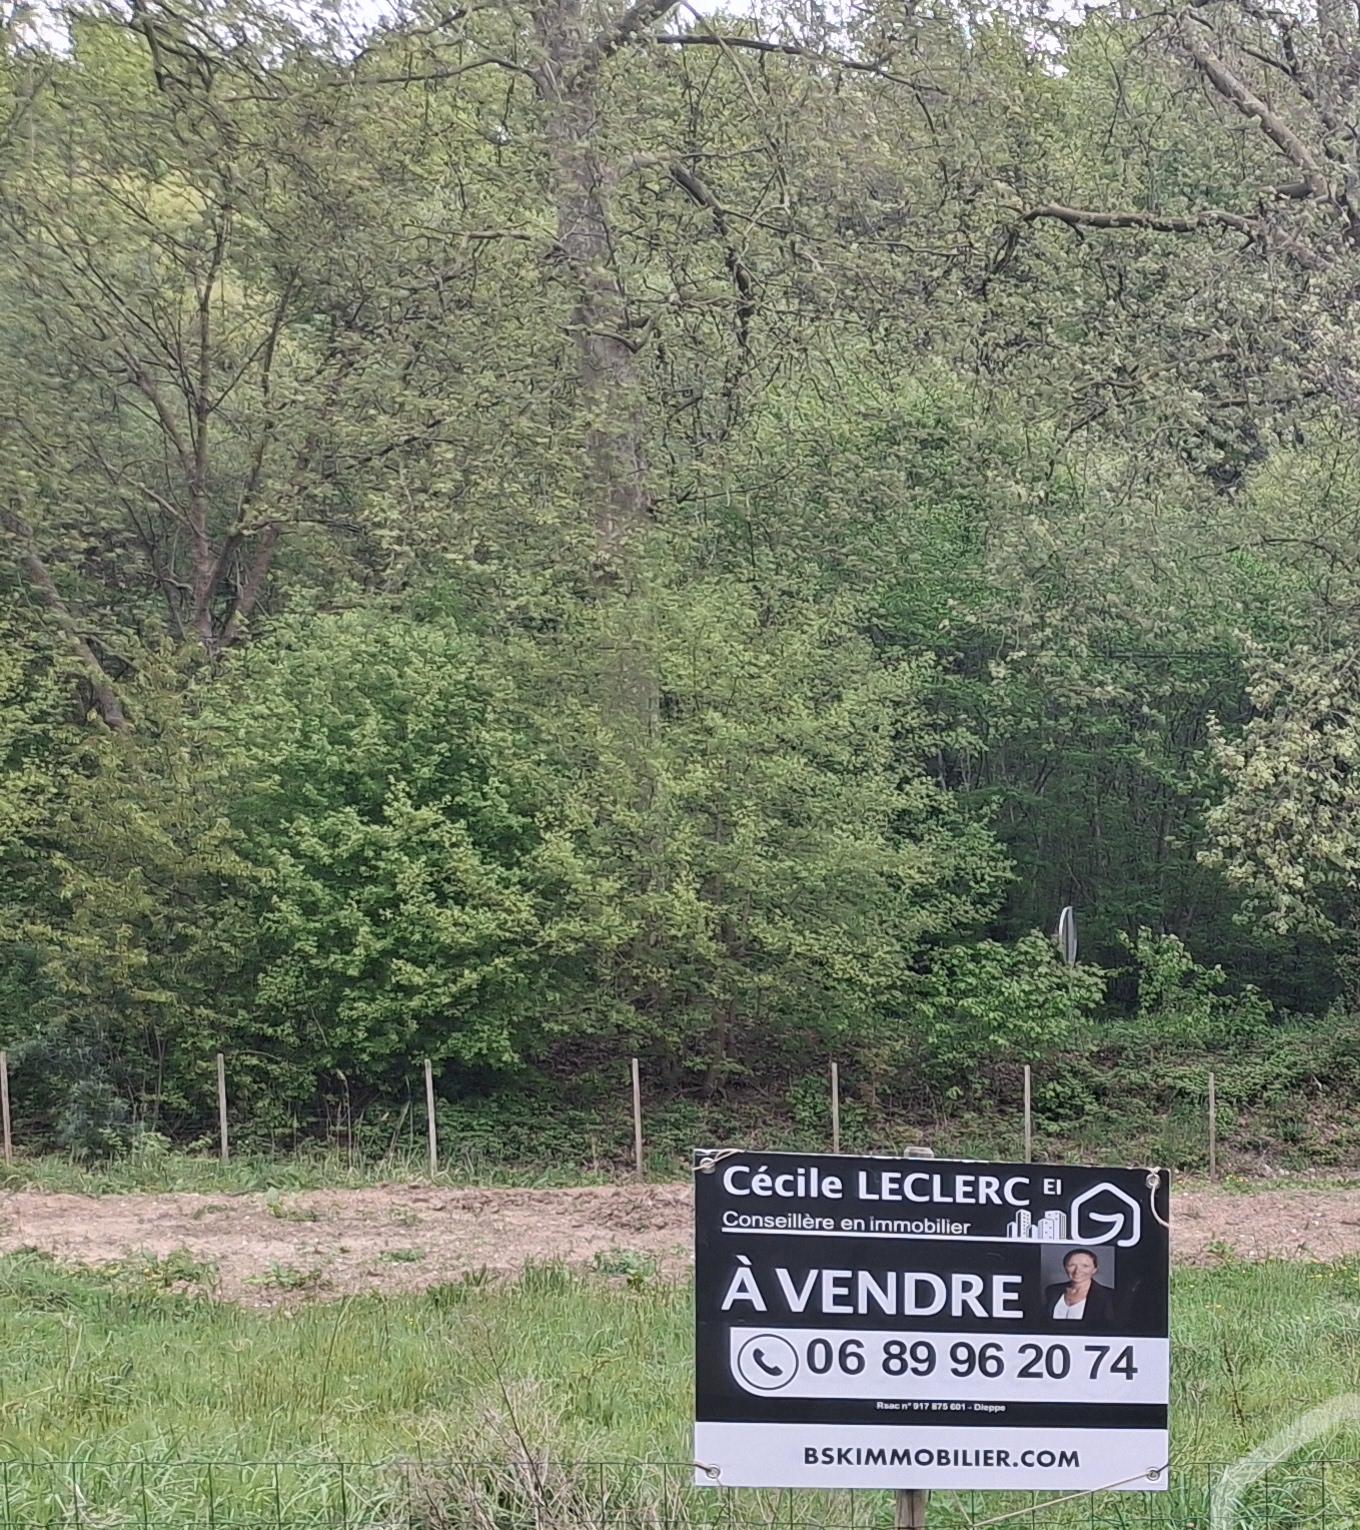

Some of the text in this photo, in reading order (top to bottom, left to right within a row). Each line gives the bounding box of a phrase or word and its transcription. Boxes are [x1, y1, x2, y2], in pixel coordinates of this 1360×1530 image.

[722, 1165, 1063, 1207] Cécile LECLERC EI
[722, 1210, 972, 1236] Conseillère en immobilier
[721, 1254, 1025, 1320] À VENDRE
[805, 1338, 1139, 1382] 06 89 96 20 74
[803, 1446, 1081, 1469] BSKIMMOBILIER.COM
